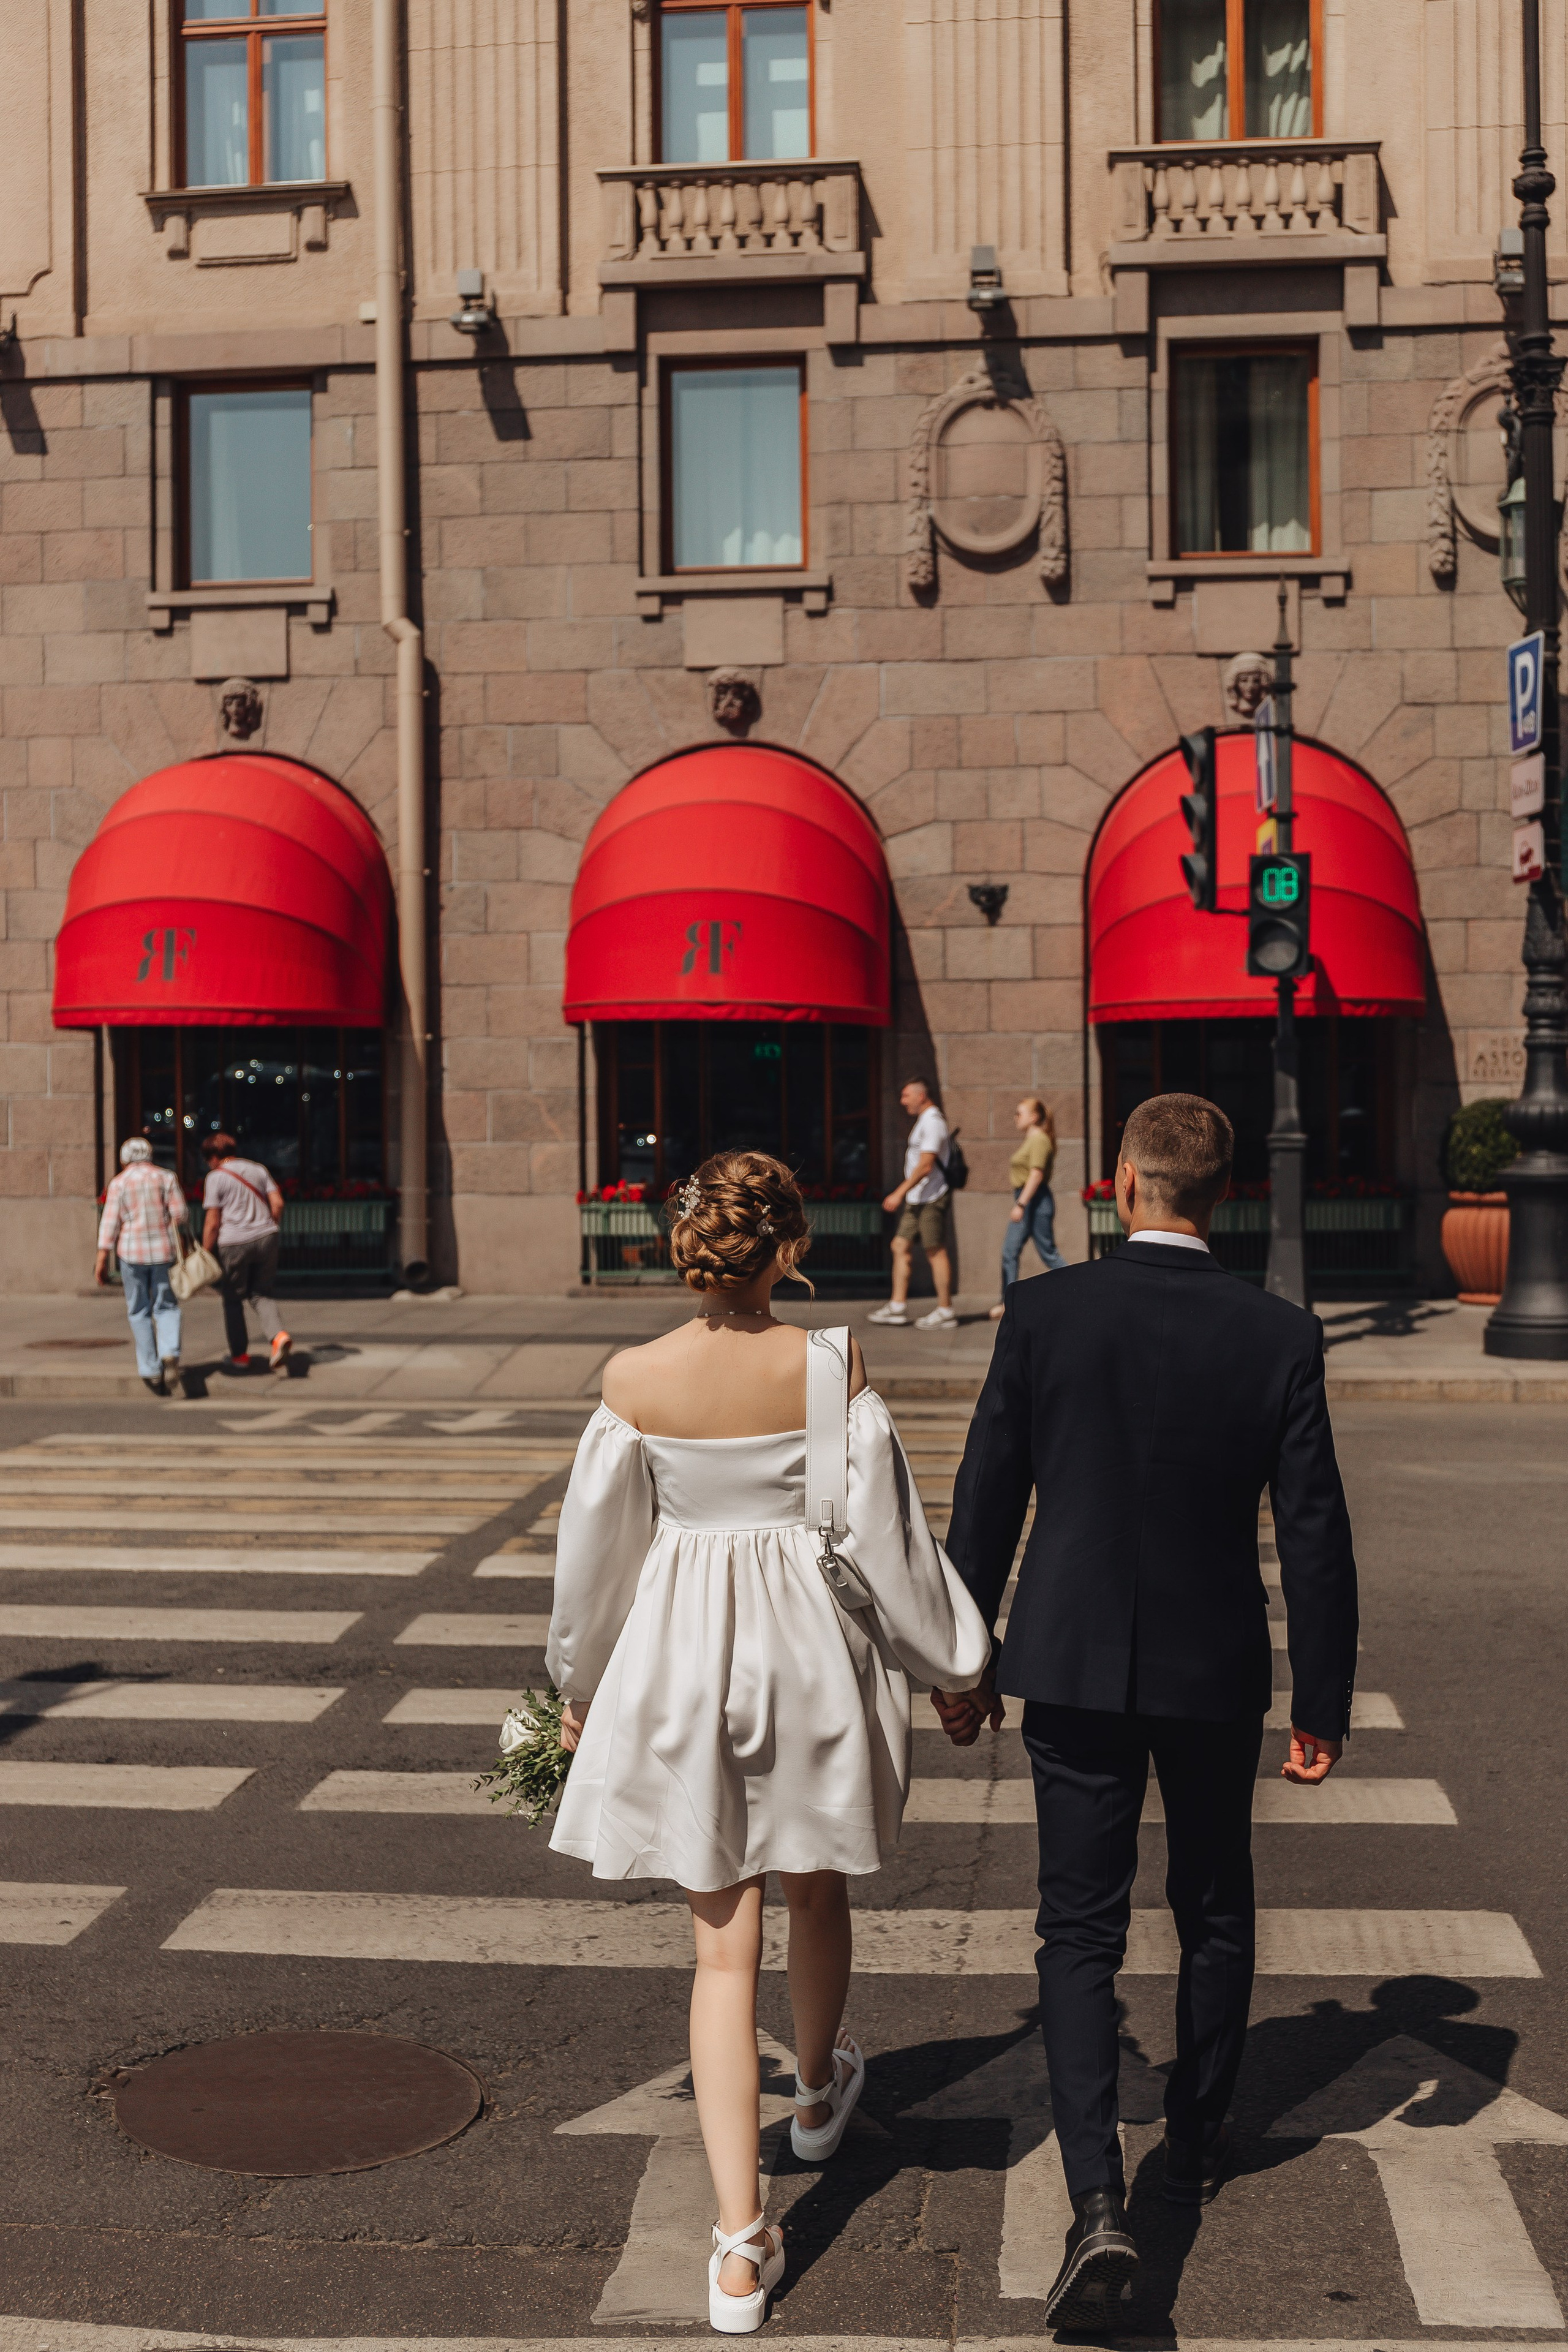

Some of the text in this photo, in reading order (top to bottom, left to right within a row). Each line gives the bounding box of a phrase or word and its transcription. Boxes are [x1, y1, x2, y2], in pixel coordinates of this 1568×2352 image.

[1515, 651, 1536, 740] P
[1262, 867, 1298, 902] 08
[1474, 1050, 1525, 1066] ASTO
